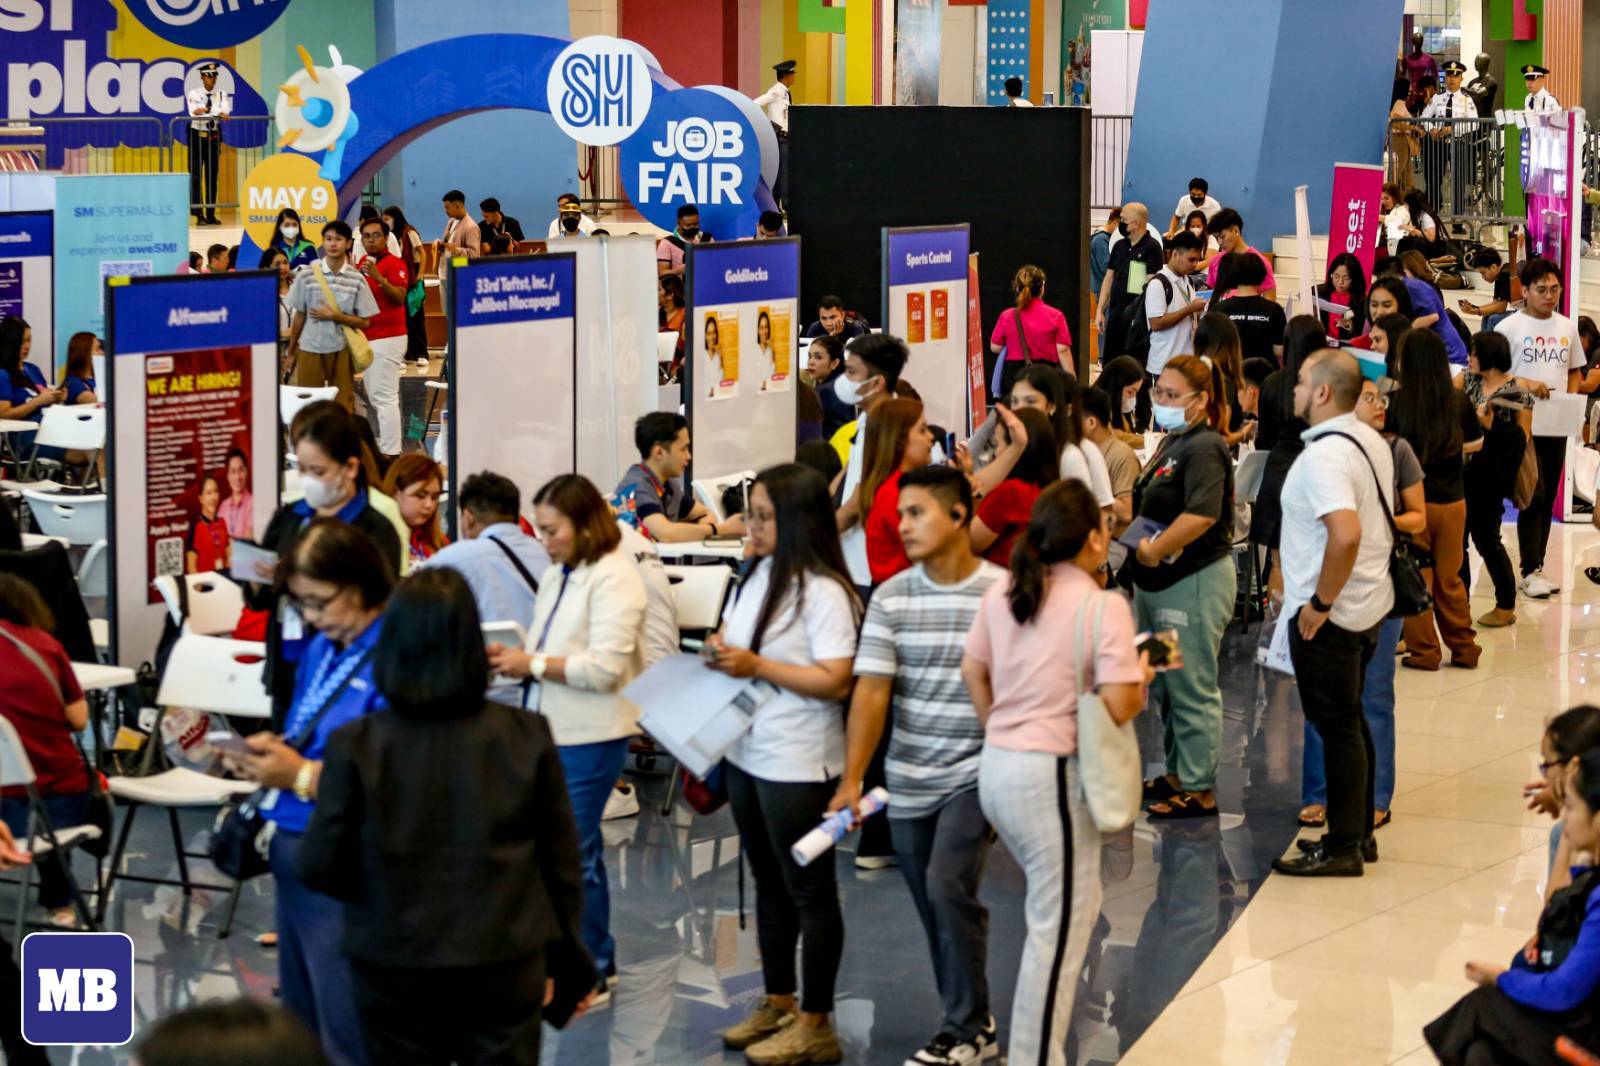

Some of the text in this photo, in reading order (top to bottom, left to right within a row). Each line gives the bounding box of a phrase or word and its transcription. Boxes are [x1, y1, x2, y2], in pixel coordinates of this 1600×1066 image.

[561, 53, 633, 128] SM
[652, 116, 745, 162] JOB
[638, 162, 744, 205] FAIR
[248, 186, 329, 210] MAY 9
[248, 215, 263, 224] SM
[306, 215, 328, 224] ASIA
[1356, 233, 1364, 249] by
[905, 249, 953, 269] Sports Central
[476, 277, 499, 293] 33rd
[724, 267, 769, 285] Goldilocks
[471, 292, 560, 313] Jollibee Macapagal
[168, 307, 228, 326] Alfamart
[147, 372, 241, 394] WE ARE HIRING!
